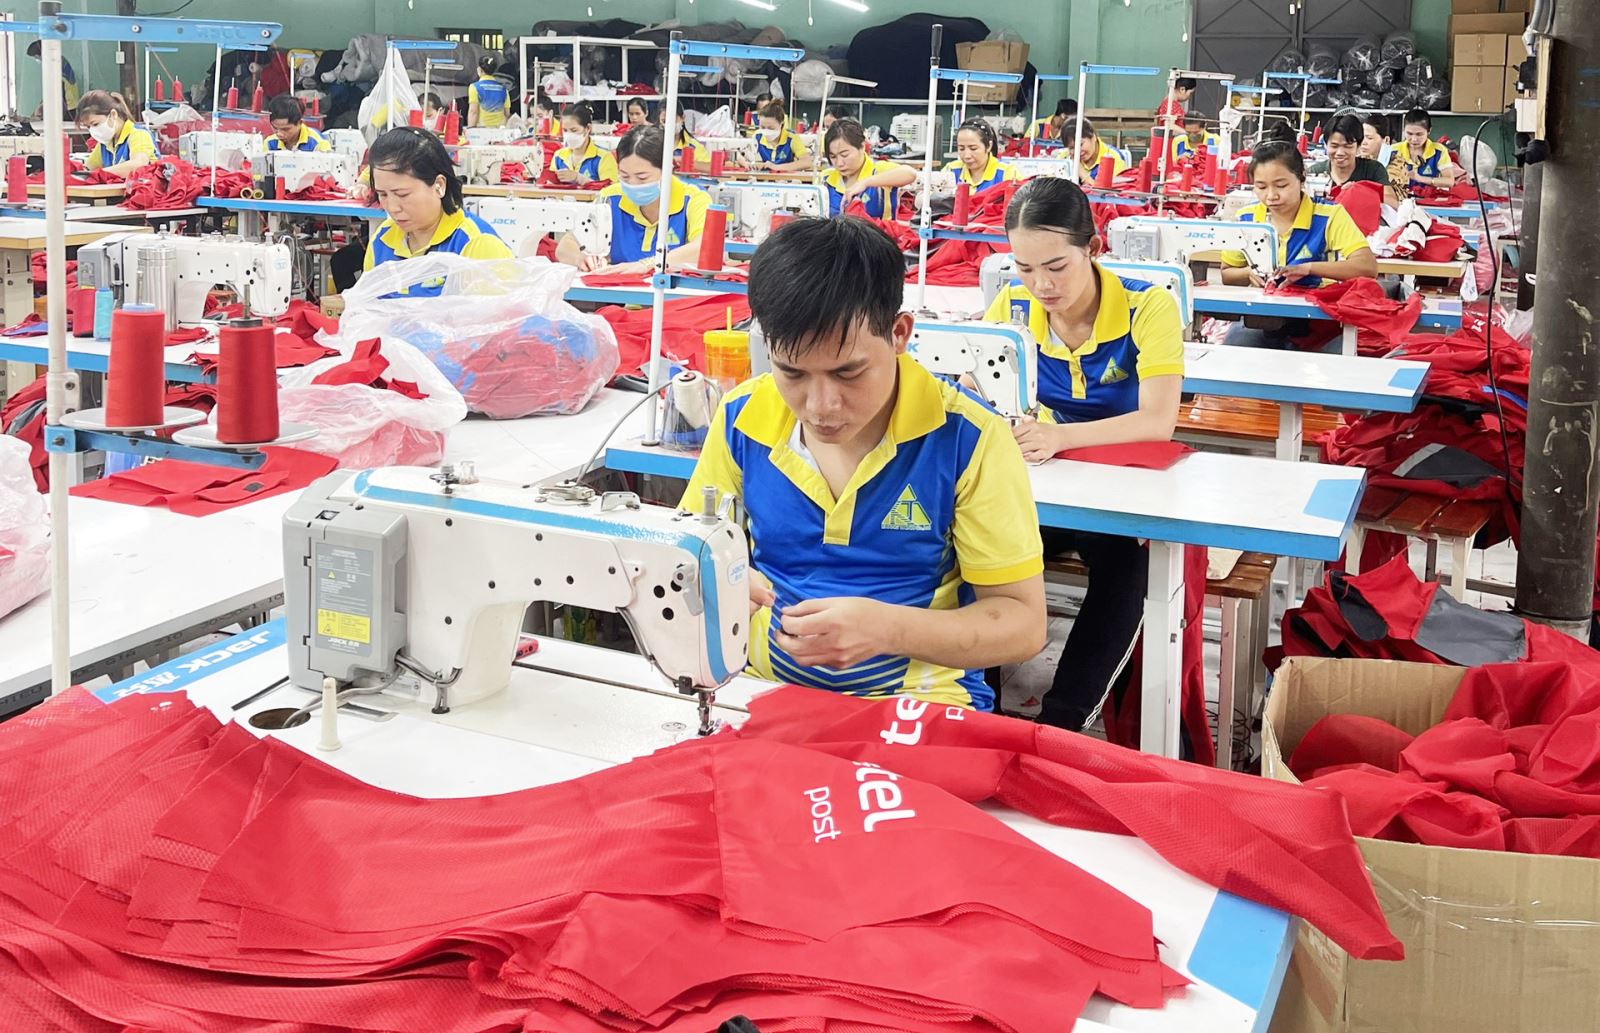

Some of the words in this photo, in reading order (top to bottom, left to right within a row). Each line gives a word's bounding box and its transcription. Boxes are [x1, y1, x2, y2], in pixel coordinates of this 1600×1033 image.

[490, 217, 516, 225] JACK
[1184, 231, 1216, 239] JACK
[176, 630, 271, 674] JACK
[803, 786, 841, 843] post
